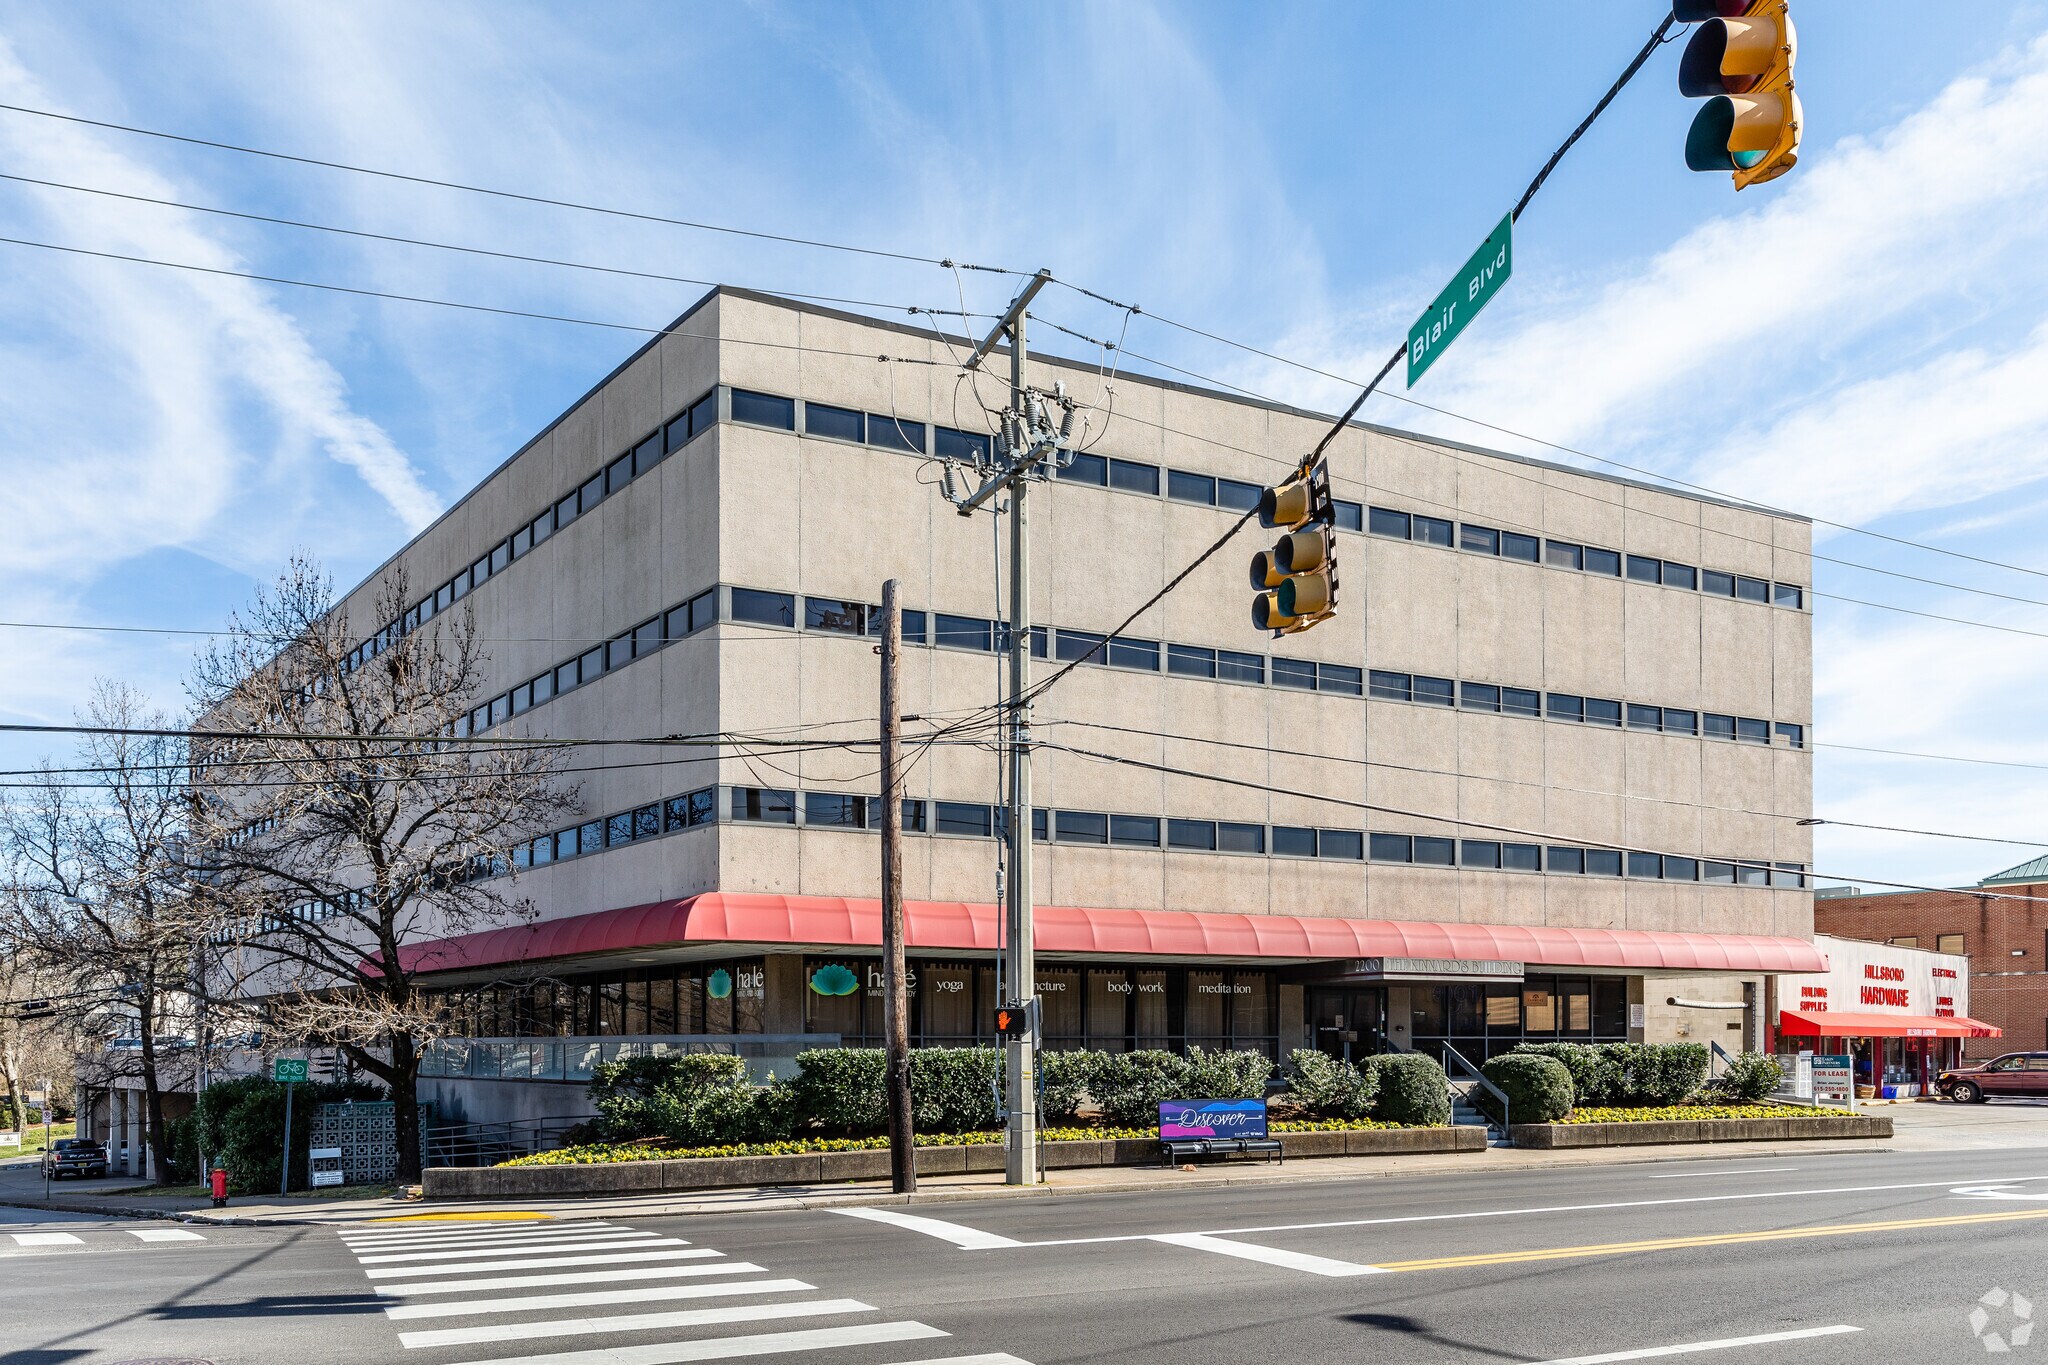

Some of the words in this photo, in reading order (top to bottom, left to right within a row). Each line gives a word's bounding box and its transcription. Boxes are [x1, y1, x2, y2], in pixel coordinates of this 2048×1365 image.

[1412, 301, 1457, 366] Blair
[1468, 243, 1506, 303] Blvd
[1354, 959, 1380, 972] 2200
[1386, 958, 1408, 971] THE
[1411, 959, 1470, 973] KINNARD'S
[1472, 960, 1522, 975] BUILDING
[867, 965, 917, 988] hé
[1864, 964, 1905, 982] HILLSBORO
[1932, 967, 1957, 979] ELECTRICAL
[936, 980, 964, 993] yoga
[999, 981, 1066, 991] ancture
[1107, 980, 1134, 994] body
[1138, 981, 1164, 993] work
[1801, 986, 1828, 998] BUILDING
[1860, 985, 1909, 1008] HARDWARE
[1800, 1000, 1828, 1012] SUPPLIES
[1178, 1108, 1247, 1128] Discover
